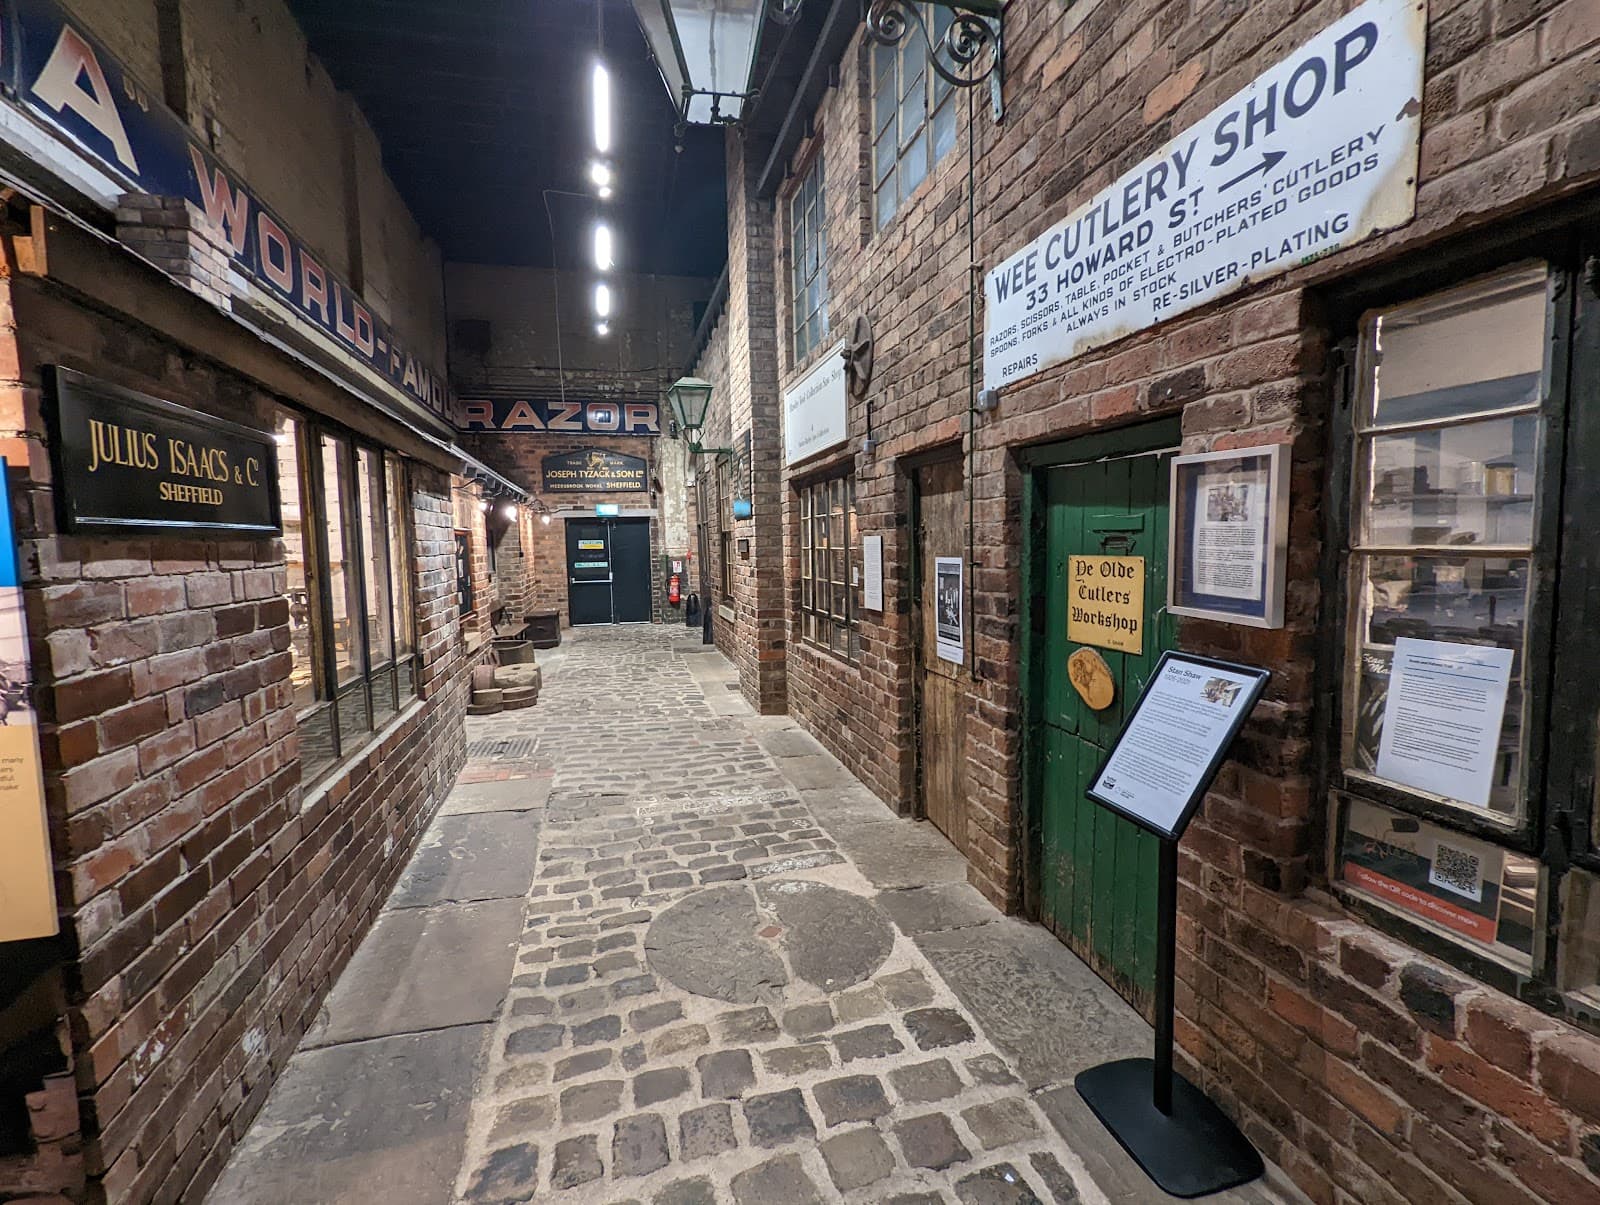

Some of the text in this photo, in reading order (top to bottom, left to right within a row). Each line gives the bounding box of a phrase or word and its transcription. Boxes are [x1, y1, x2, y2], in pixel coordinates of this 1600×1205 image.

[995, 21, 1378, 304] WEE CUTLERY SHOP
[1103, 250, 1150, 285] POCKET
[1157, 244, 1165, 256] &
[1272, 123, 1386, 196] CUTLERY
[1022, 322, 1049, 341] FORKS
[1052, 317, 1058, 327] &
[1060, 307, 1079, 324] ALL
[1082, 287, 1114, 311] KINDS
[1119, 273, 1134, 293] OF
[1140, 199, 1287, 282] ELECTRO-PLATED
[1297, 152, 1380, 204] GOODS
[1025, 283, 1049, 311] 33
[1056, 219, 1154, 293] HOWARD
[1066, 271, 1178, 334] ALWAYS IN STOCK
[1002, 353, 1038, 378] REPAIRS
[461, 400, 660, 432] RAZOR
[88, 419, 159, 472] JULIUS
[168, 439, 229, 482] ISAACS
[234, 465, 243, 485] &
[546, 470, 577, 478] JOSEPH
[579, 470, 610, 478] TYZACK
[616, 470, 634, 478] SON
[606, 481, 641, 489] SHEFFIELD
[159, 481, 224, 506] SHEFFIELD
[1100, 561, 1135, 579] Olde
[1078, 584, 1131, 605] Cutlers
[1072, 606, 1138, 635] Workshop
[1167, 665, 1201, 680] Stan Shaw
